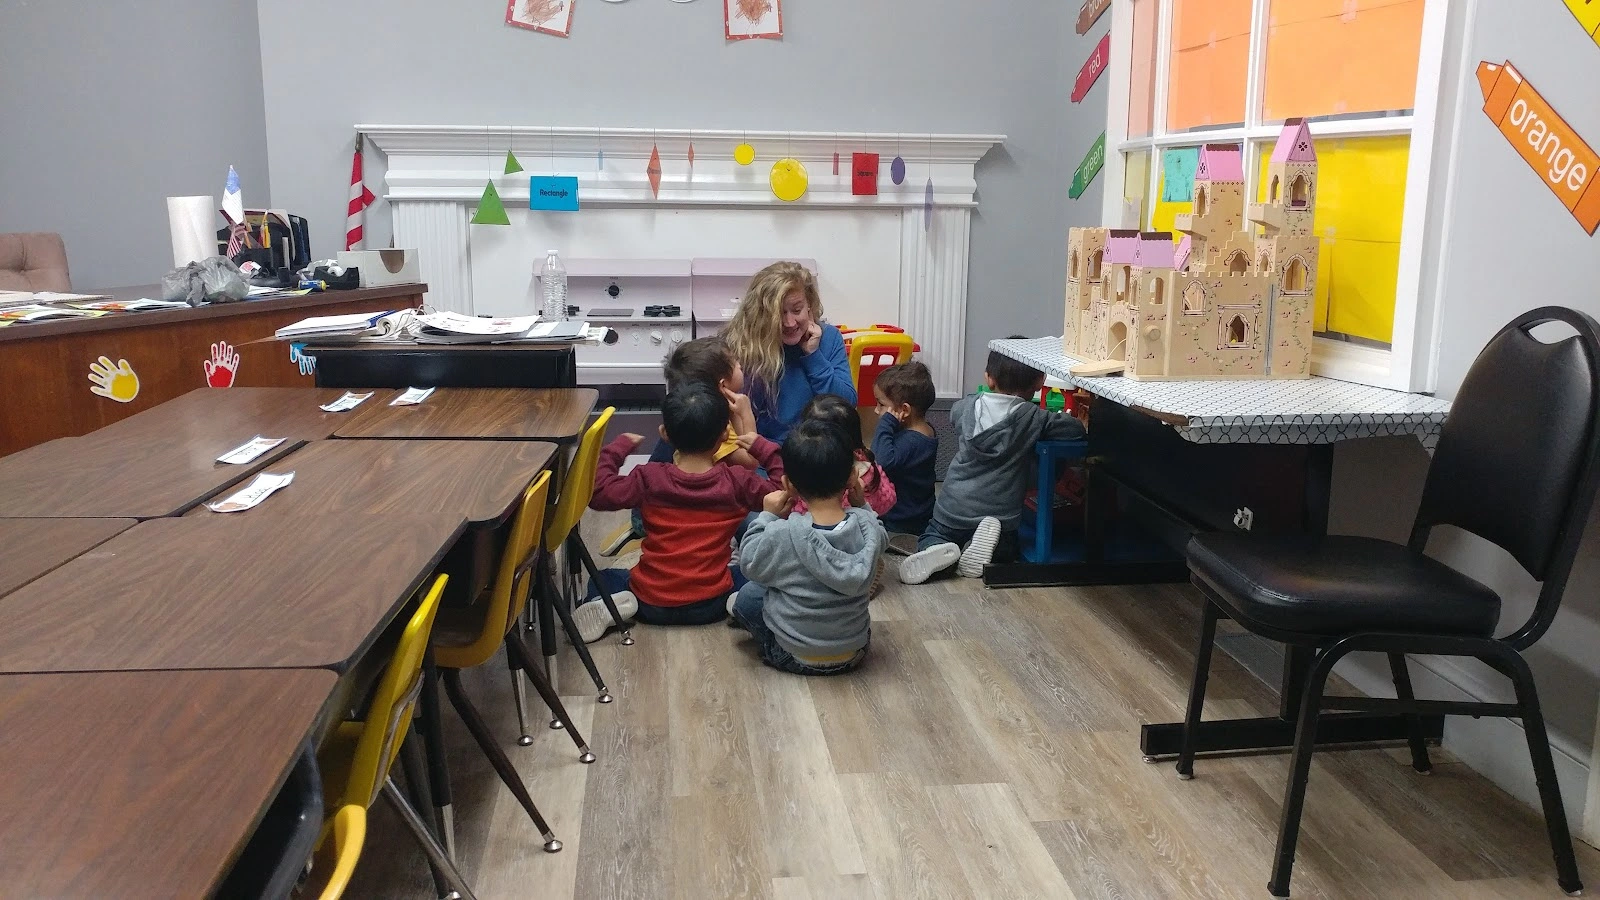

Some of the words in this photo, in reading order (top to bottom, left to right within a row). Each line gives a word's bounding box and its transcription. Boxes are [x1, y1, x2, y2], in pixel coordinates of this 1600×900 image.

[1089, 48, 1101, 78] red
[1510, 99, 1587, 191] orange
[1083, 144, 1103, 184] green
[539, 188, 569, 199] Rectangle
